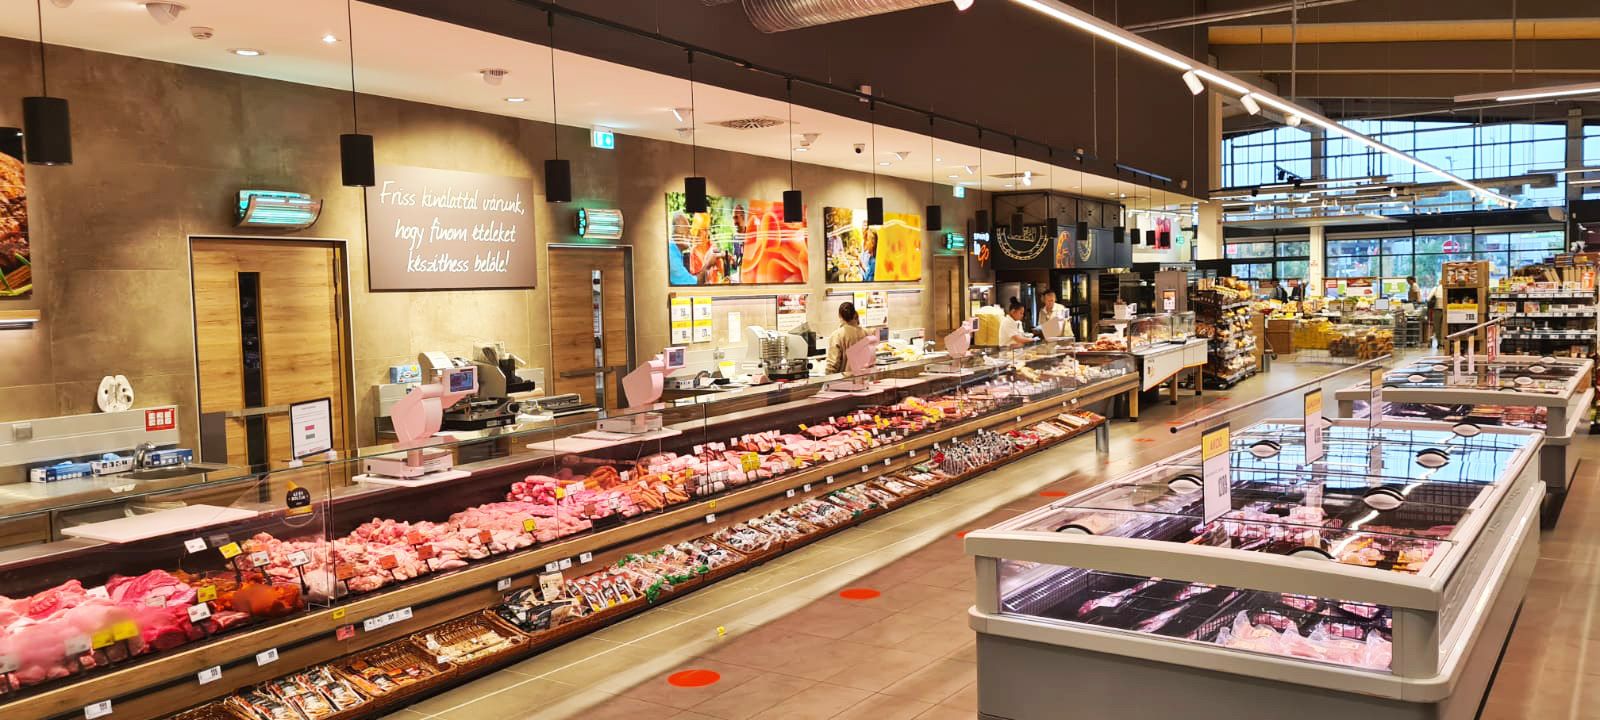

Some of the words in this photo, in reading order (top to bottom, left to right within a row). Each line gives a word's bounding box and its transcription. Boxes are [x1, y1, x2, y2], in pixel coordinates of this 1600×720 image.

[379, 180, 416, 206] Friss
[482, 192, 525, 216] várunk,
[394, 218, 425, 251] hogy
[429, 216, 468, 243] finom
